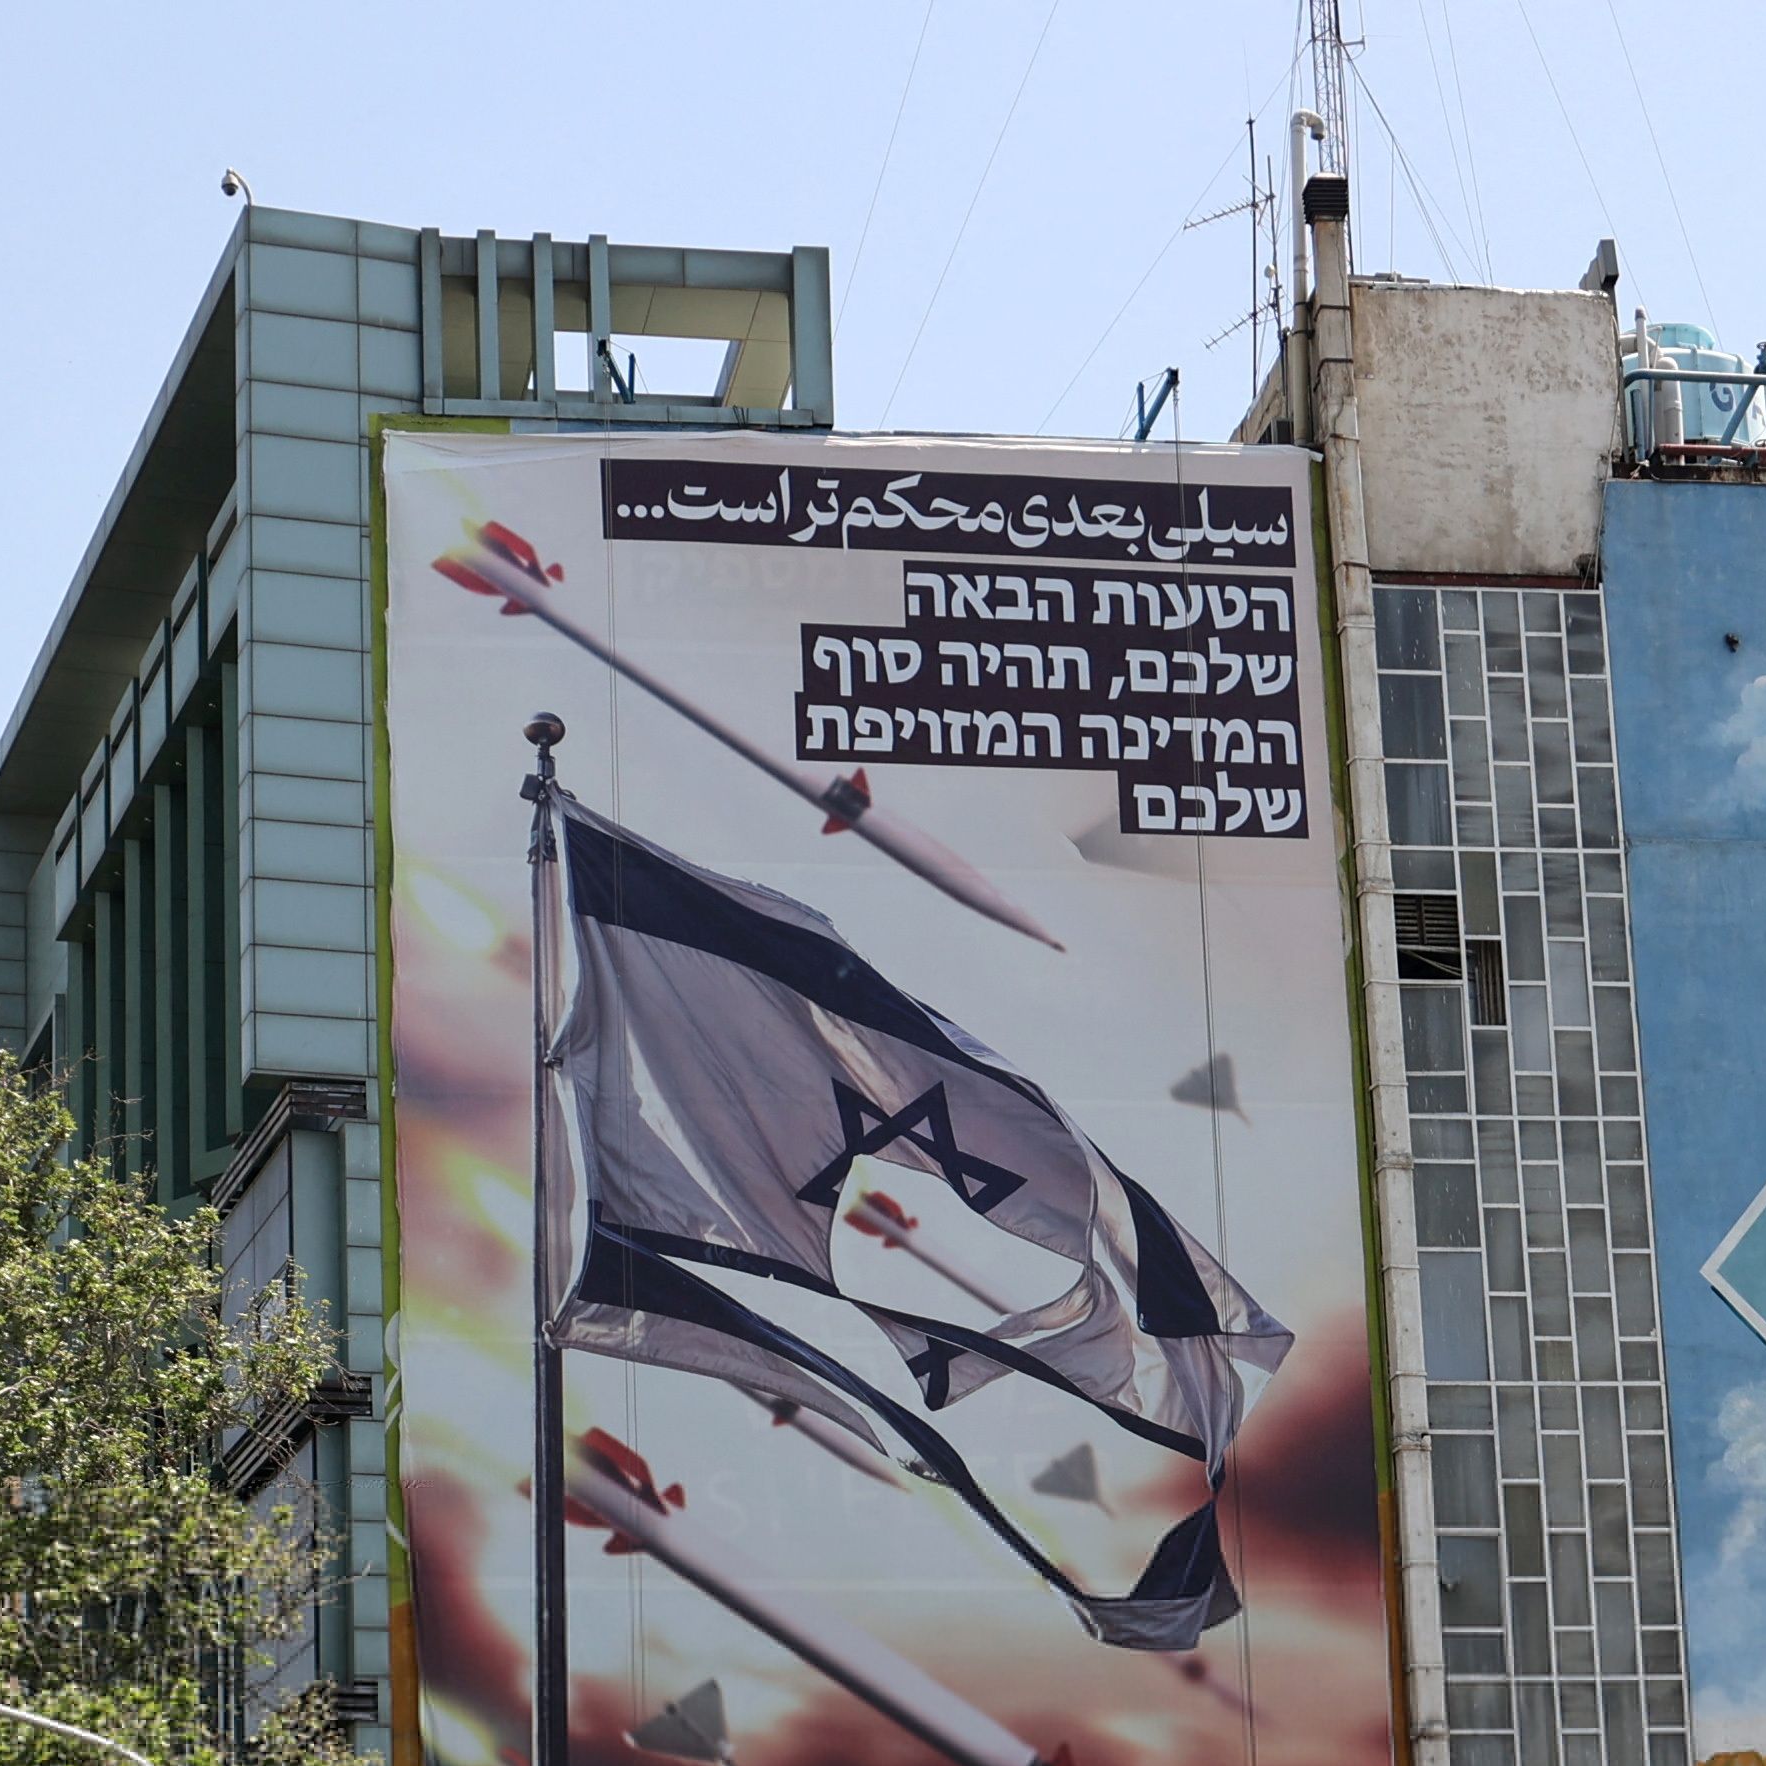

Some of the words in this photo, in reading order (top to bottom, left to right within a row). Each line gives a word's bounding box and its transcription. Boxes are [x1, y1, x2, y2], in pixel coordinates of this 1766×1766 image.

[1006, 493, 1142, 557] بعدی
[1148, 487, 1288, 561] سیلی
[905, 571, 1076, 624] הבאה
[1092, 579, 1292, 633] הטעות
[812, 634, 924, 697] סוף
[938, 639, 1092, 691] תהיה
[1107, 636, 1294, 702] שלכם,
[805, 703, 1064, 758] המזויפת
[1078, 713, 1300, 765] המדינה
[1132, 770, 1303, 834] שלכם
